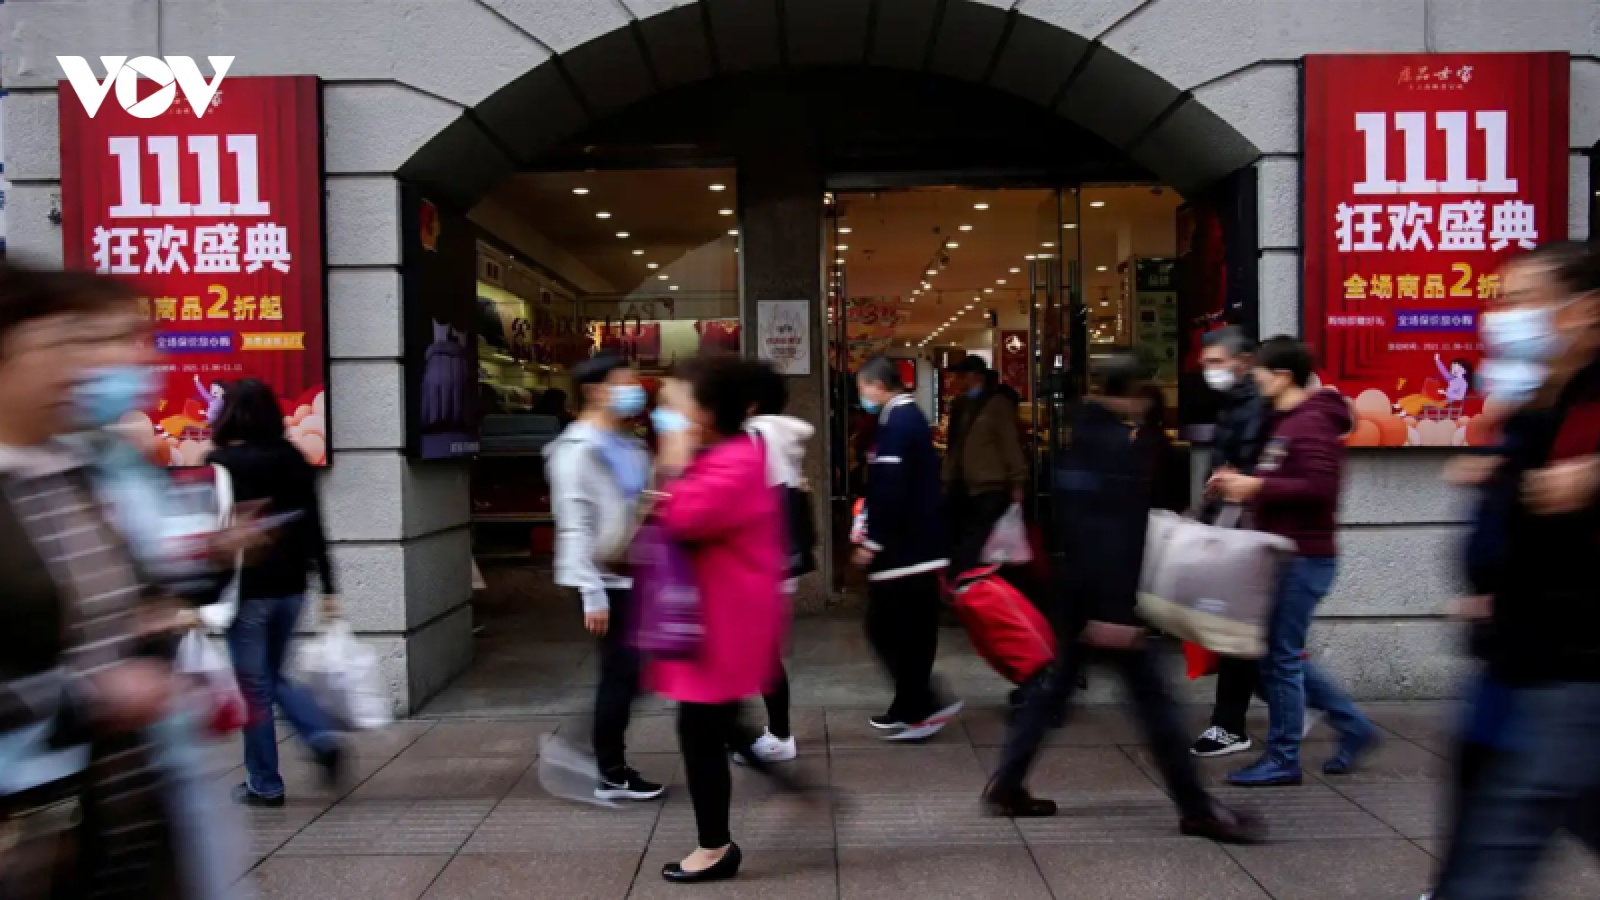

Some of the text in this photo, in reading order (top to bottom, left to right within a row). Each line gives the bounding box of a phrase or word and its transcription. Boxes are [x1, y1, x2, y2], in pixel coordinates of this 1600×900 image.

[108, 134, 270, 217] 1111
[1353, 110, 1518, 194] 1111
[92, 222, 291, 274] 狂欢盛典
[1335, 200, 1538, 252] 狂欢盛典
